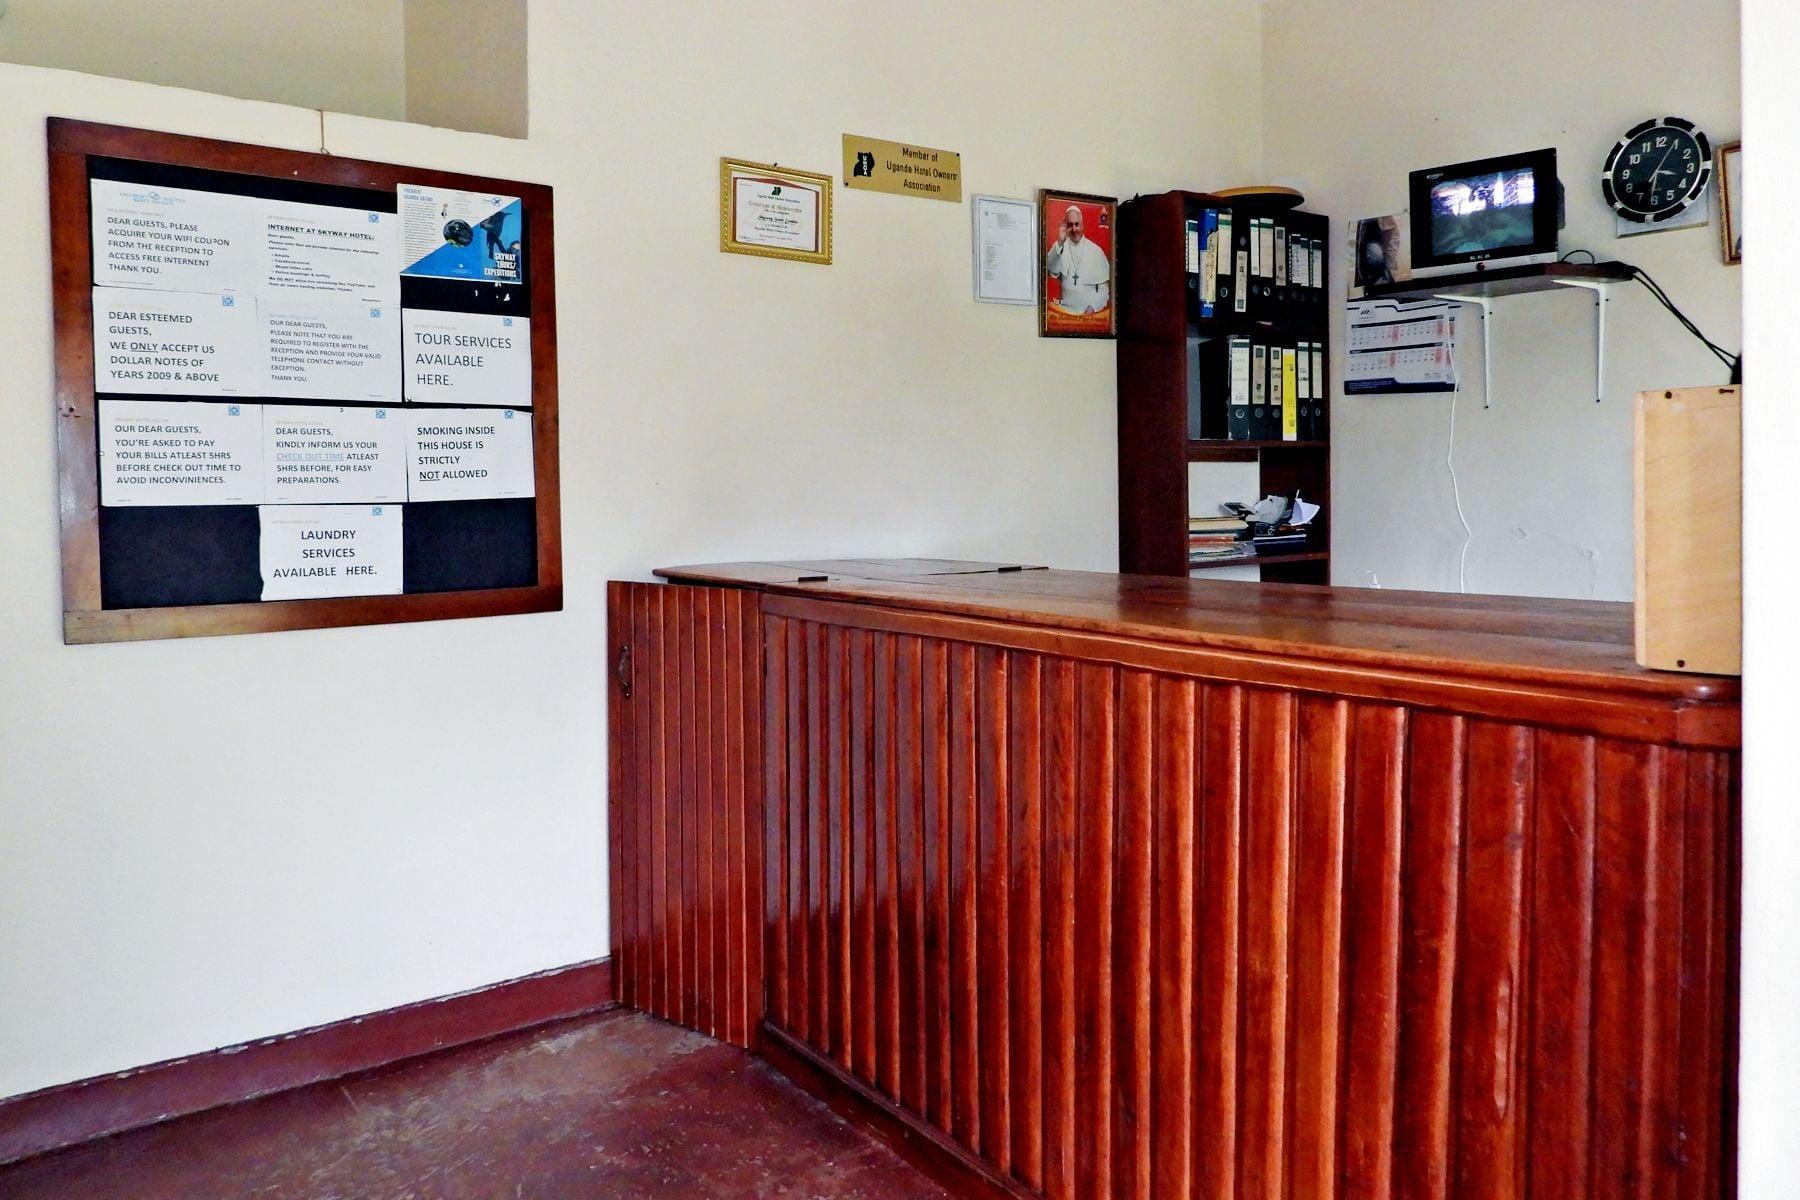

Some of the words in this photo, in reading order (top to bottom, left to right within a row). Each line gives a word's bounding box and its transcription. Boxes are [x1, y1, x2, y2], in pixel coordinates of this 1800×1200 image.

[1641, 142, 1651, 152] 11
[1656, 136, 1667, 148] 12
[1674, 139, 1679, 149] 1
[903, 148, 929, 160] Member
[932, 153, 938, 162] of
[1683, 148, 1691, 159] 2
[1629, 154, 1640, 165] 10
[886, 161, 912, 173] Uganda
[914, 166, 931, 177] Hotel
[1686, 163, 1695, 173] 3
[1623, 169, 1630, 180] 9
[904, 179, 940, 192] Association
[1626, 183, 1633, 193] 8
[1679, 178, 1686, 188] 4
[1636, 193, 1644, 202] 7
[1666, 190, 1674, 200] 5
[1651, 195, 1658, 206] 6
[108, 217, 130, 226] DEAR
[133, 219, 168, 229] GUESTS,
[170, 222, 198, 231] PLEASE
[268, 224, 304, 233] INTERNET
[108, 228, 146, 238] ACQUIRE
[148, 232, 172, 241] YOUR
[174, 234, 192, 243] WIFI
[194, 236, 230, 246] COUPON
[108, 240, 135, 248] FROM
[136, 242, 152, 251] THE
[155, 244, 200, 254] RECEPTION
[202, 248, 214, 256] TO
[109, 252, 140, 261] ACCESS
[142, 254, 162, 263] FREE
[164, 257, 210, 267] INTERNENT
[494, 252, 516, 261] SKYWAY
[109, 264, 139, 273] THANK
[141, 266, 162, 274] YOU.
[109, 311, 137, 321] DEAR
[140, 313, 193, 323] ESTEEMED
[109, 326, 152, 336] GUESTS,
[415, 333, 451, 345] TOUR
[455, 336, 512, 349] SERVICES
[110, 342, 127, 350] WE
[130, 342, 158, 352] ONLY
[161, 344, 199, 353] ACCEPT
[202, 345, 215, 353] US
[111, 356, 152, 365] DOLLAR
[154, 358, 188, 366] NOTES
[191, 359, 204, 367] OF
[416, 354, 483, 367] AVAILABLE
[111, 370, 144, 379] YEARS
[147, 372, 172, 380] 2009
[174, 372, 182, 380] &
[186, 373, 219, 382] ABOVE
[417, 374, 453, 386] HERE.
[165, 426, 202, 434] GUESTS,
[300, 428, 333, 436] GUESTS,
[417, 426, 462, 436] SMOKING
[466, 426, 495, 435] INSIDE
[116, 439, 150, 447] YOU'RE
[276, 441, 306, 449] KINDLY
[417, 441, 438, 450] THIS
[441, 441, 472, 449] HOUSE
[476, 441, 484, 449] IS
[276, 453, 302, 461] CHECK
[305, 453, 322, 461] OUT
[325, 453, 344, 461] TIME
[419, 456, 460, 464] STRICTLY
[116, 464, 151, 472] BEFORE
[154, 464, 182, 472] CHECK
[185, 464, 203, 472] OUT
[205, 464, 227, 472] TIME
[229, 464, 241, 472] TO
[420, 471, 440, 480] NOT
[442, 470, 488, 478] ALLOWED
[301, 530, 356, 540] LAUNDRY
[303, 548, 355, 558] SERVICES
[273, 567, 336, 578] AVAILABLE
[346, 565, 377, 575] HERE.
